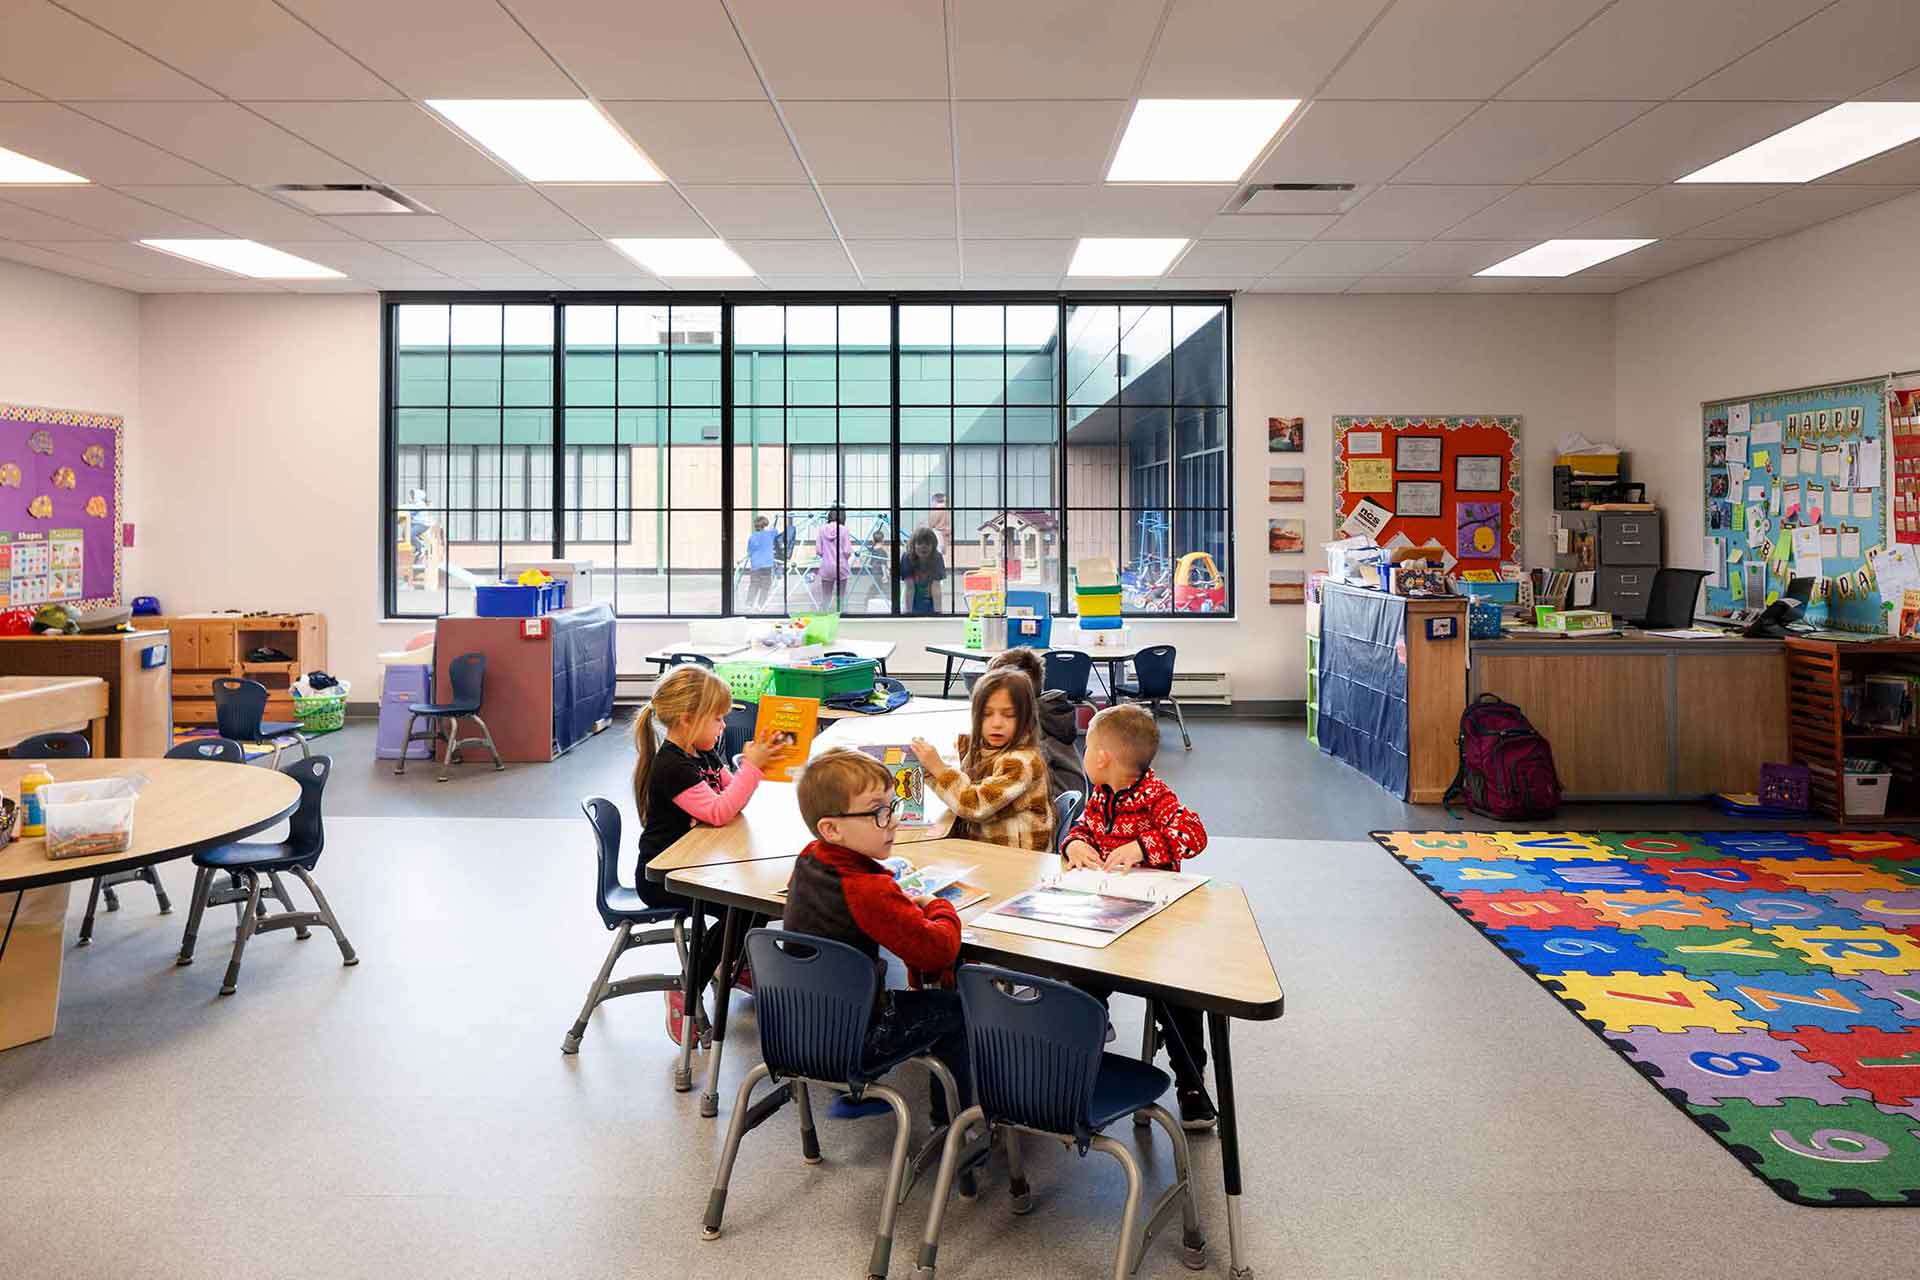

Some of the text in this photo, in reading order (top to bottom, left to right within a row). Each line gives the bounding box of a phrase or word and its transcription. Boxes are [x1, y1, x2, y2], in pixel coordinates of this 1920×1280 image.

[1788, 408, 1860, 433] HAPPY
[1412, 839, 1469, 849] 3
[1515, 837, 1590, 850] V
[1720, 840, 1805, 851] H
[1828, 839, 1904, 853] A
[1457, 867, 1518, 880] 4
[1552, 865, 1643, 886] W
[1669, 867, 1752, 883] P
[1489, 900, 1561, 917] 5
[1602, 899, 1703, 918] X
[1735, 898, 1824, 922] Q
[1543, 937, 1619, 956] 6
[1675, 938, 1780, 959] Y
[1802, 938, 1901, 959] R
[1604, 990, 1697, 1010] 7
[1734, 984, 1863, 1015] Z
[1688, 1050, 1781, 1079] 8
[1770, 1128, 1890, 1164] 9
